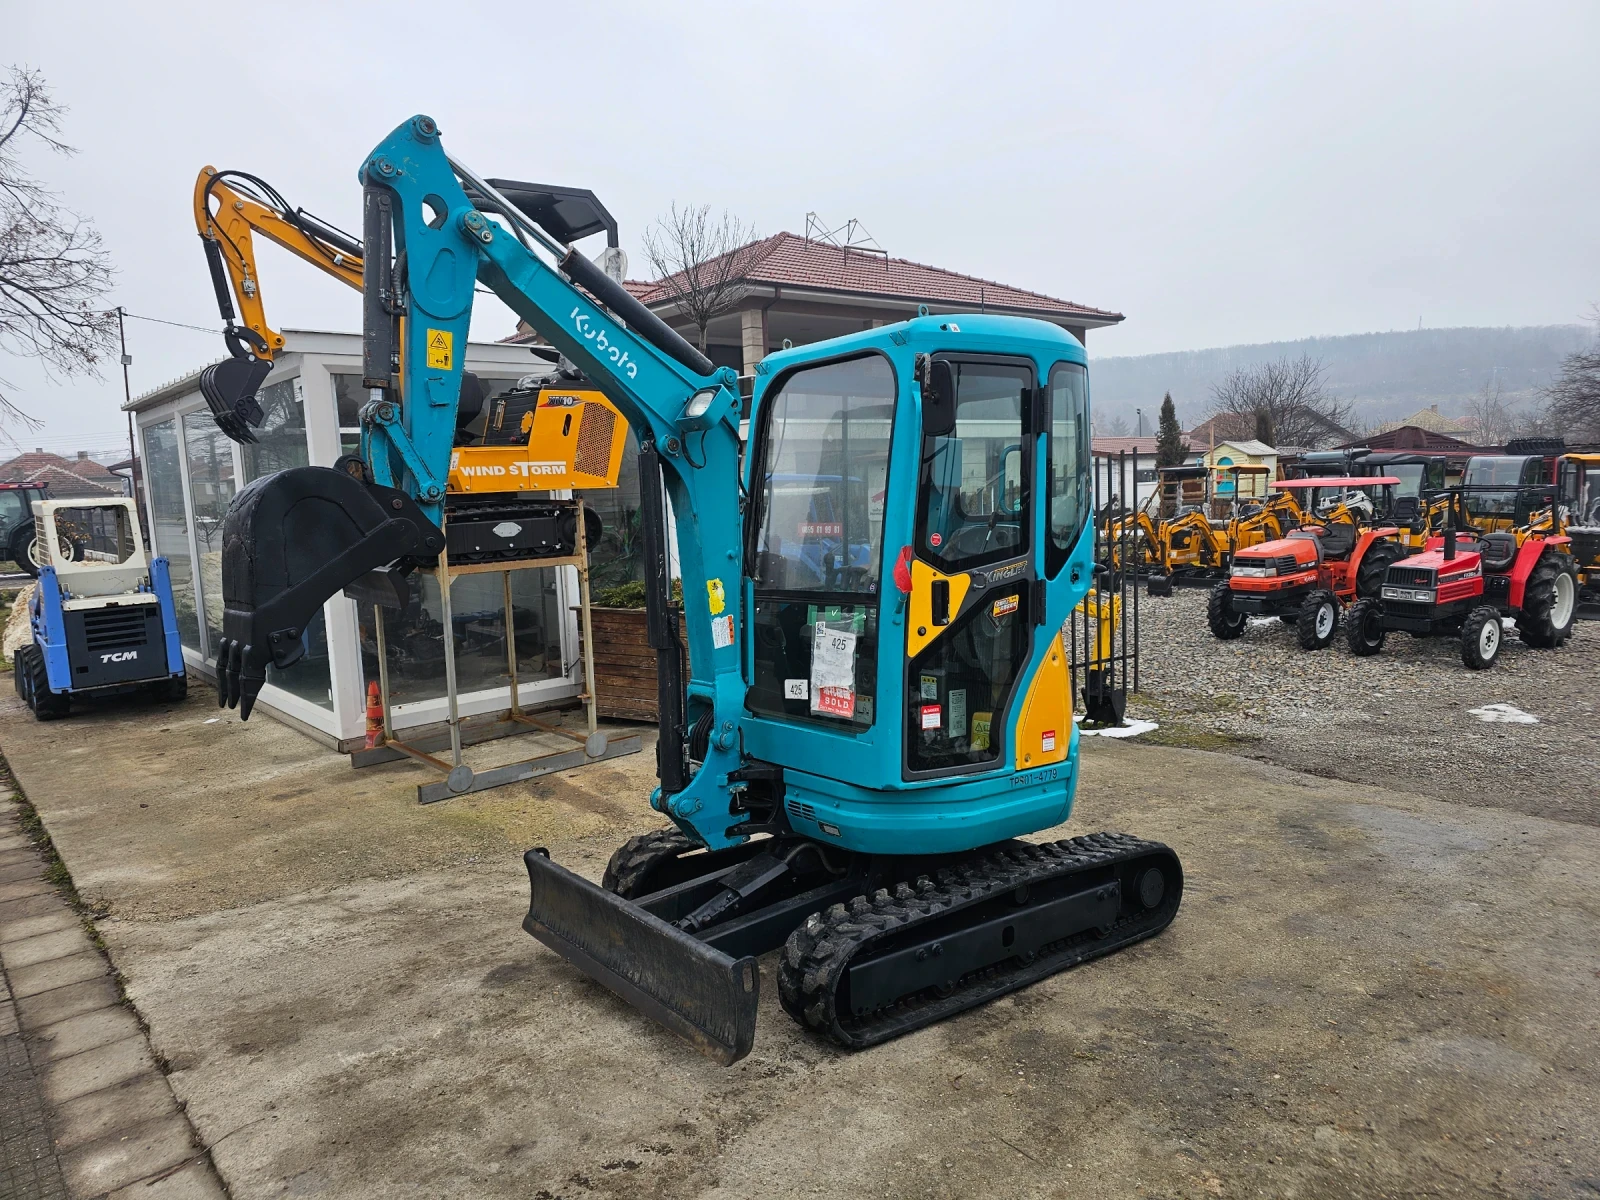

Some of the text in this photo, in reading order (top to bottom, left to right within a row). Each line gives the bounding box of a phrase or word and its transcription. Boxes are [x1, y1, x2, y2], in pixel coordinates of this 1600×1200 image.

[570, 306, 638, 380] Kubota
[460, 461, 567, 477] WIND STORM
[831, 637, 847, 650] 425
[100, 650, 138, 664] TCM
[790, 684, 803, 695] 425
[824, 696, 849, 709] SOLD
